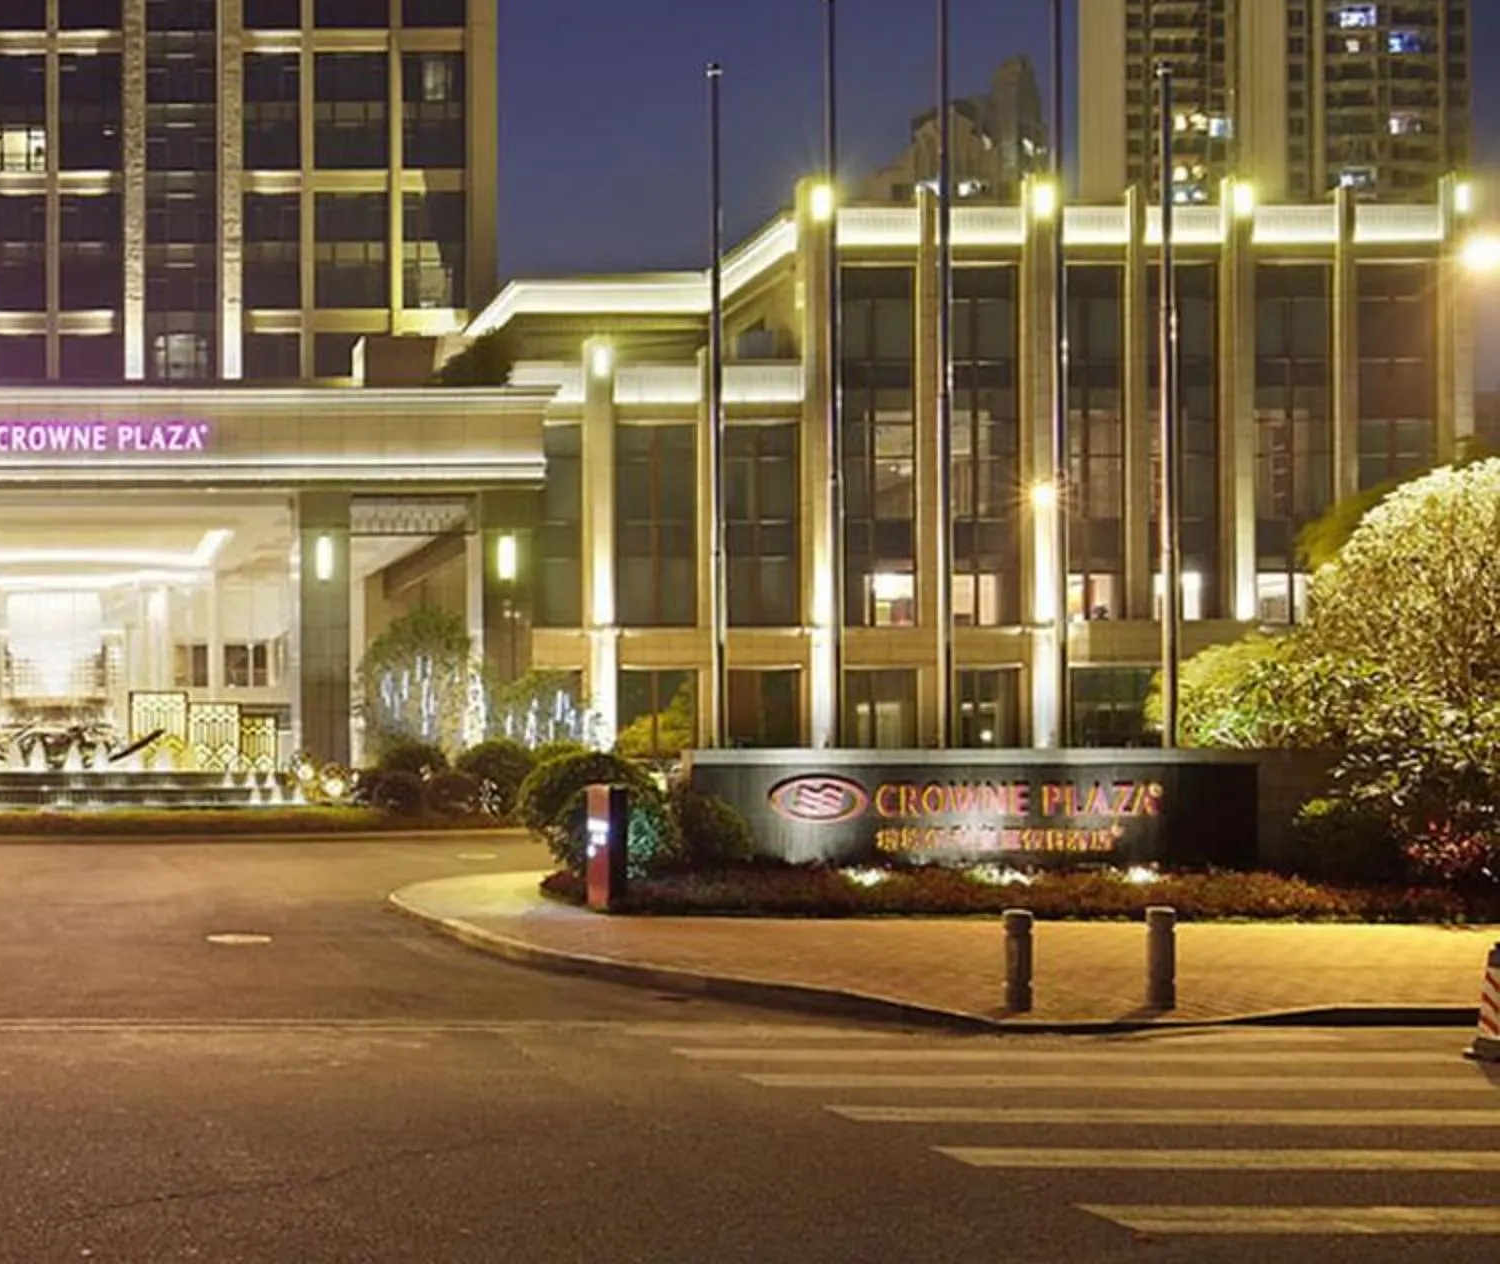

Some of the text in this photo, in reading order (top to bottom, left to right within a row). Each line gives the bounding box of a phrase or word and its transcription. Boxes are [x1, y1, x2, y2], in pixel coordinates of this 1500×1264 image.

[117, 424, 204, 451] PLAZA
[874, 781, 1159, 818] CROWNE PLAZA
